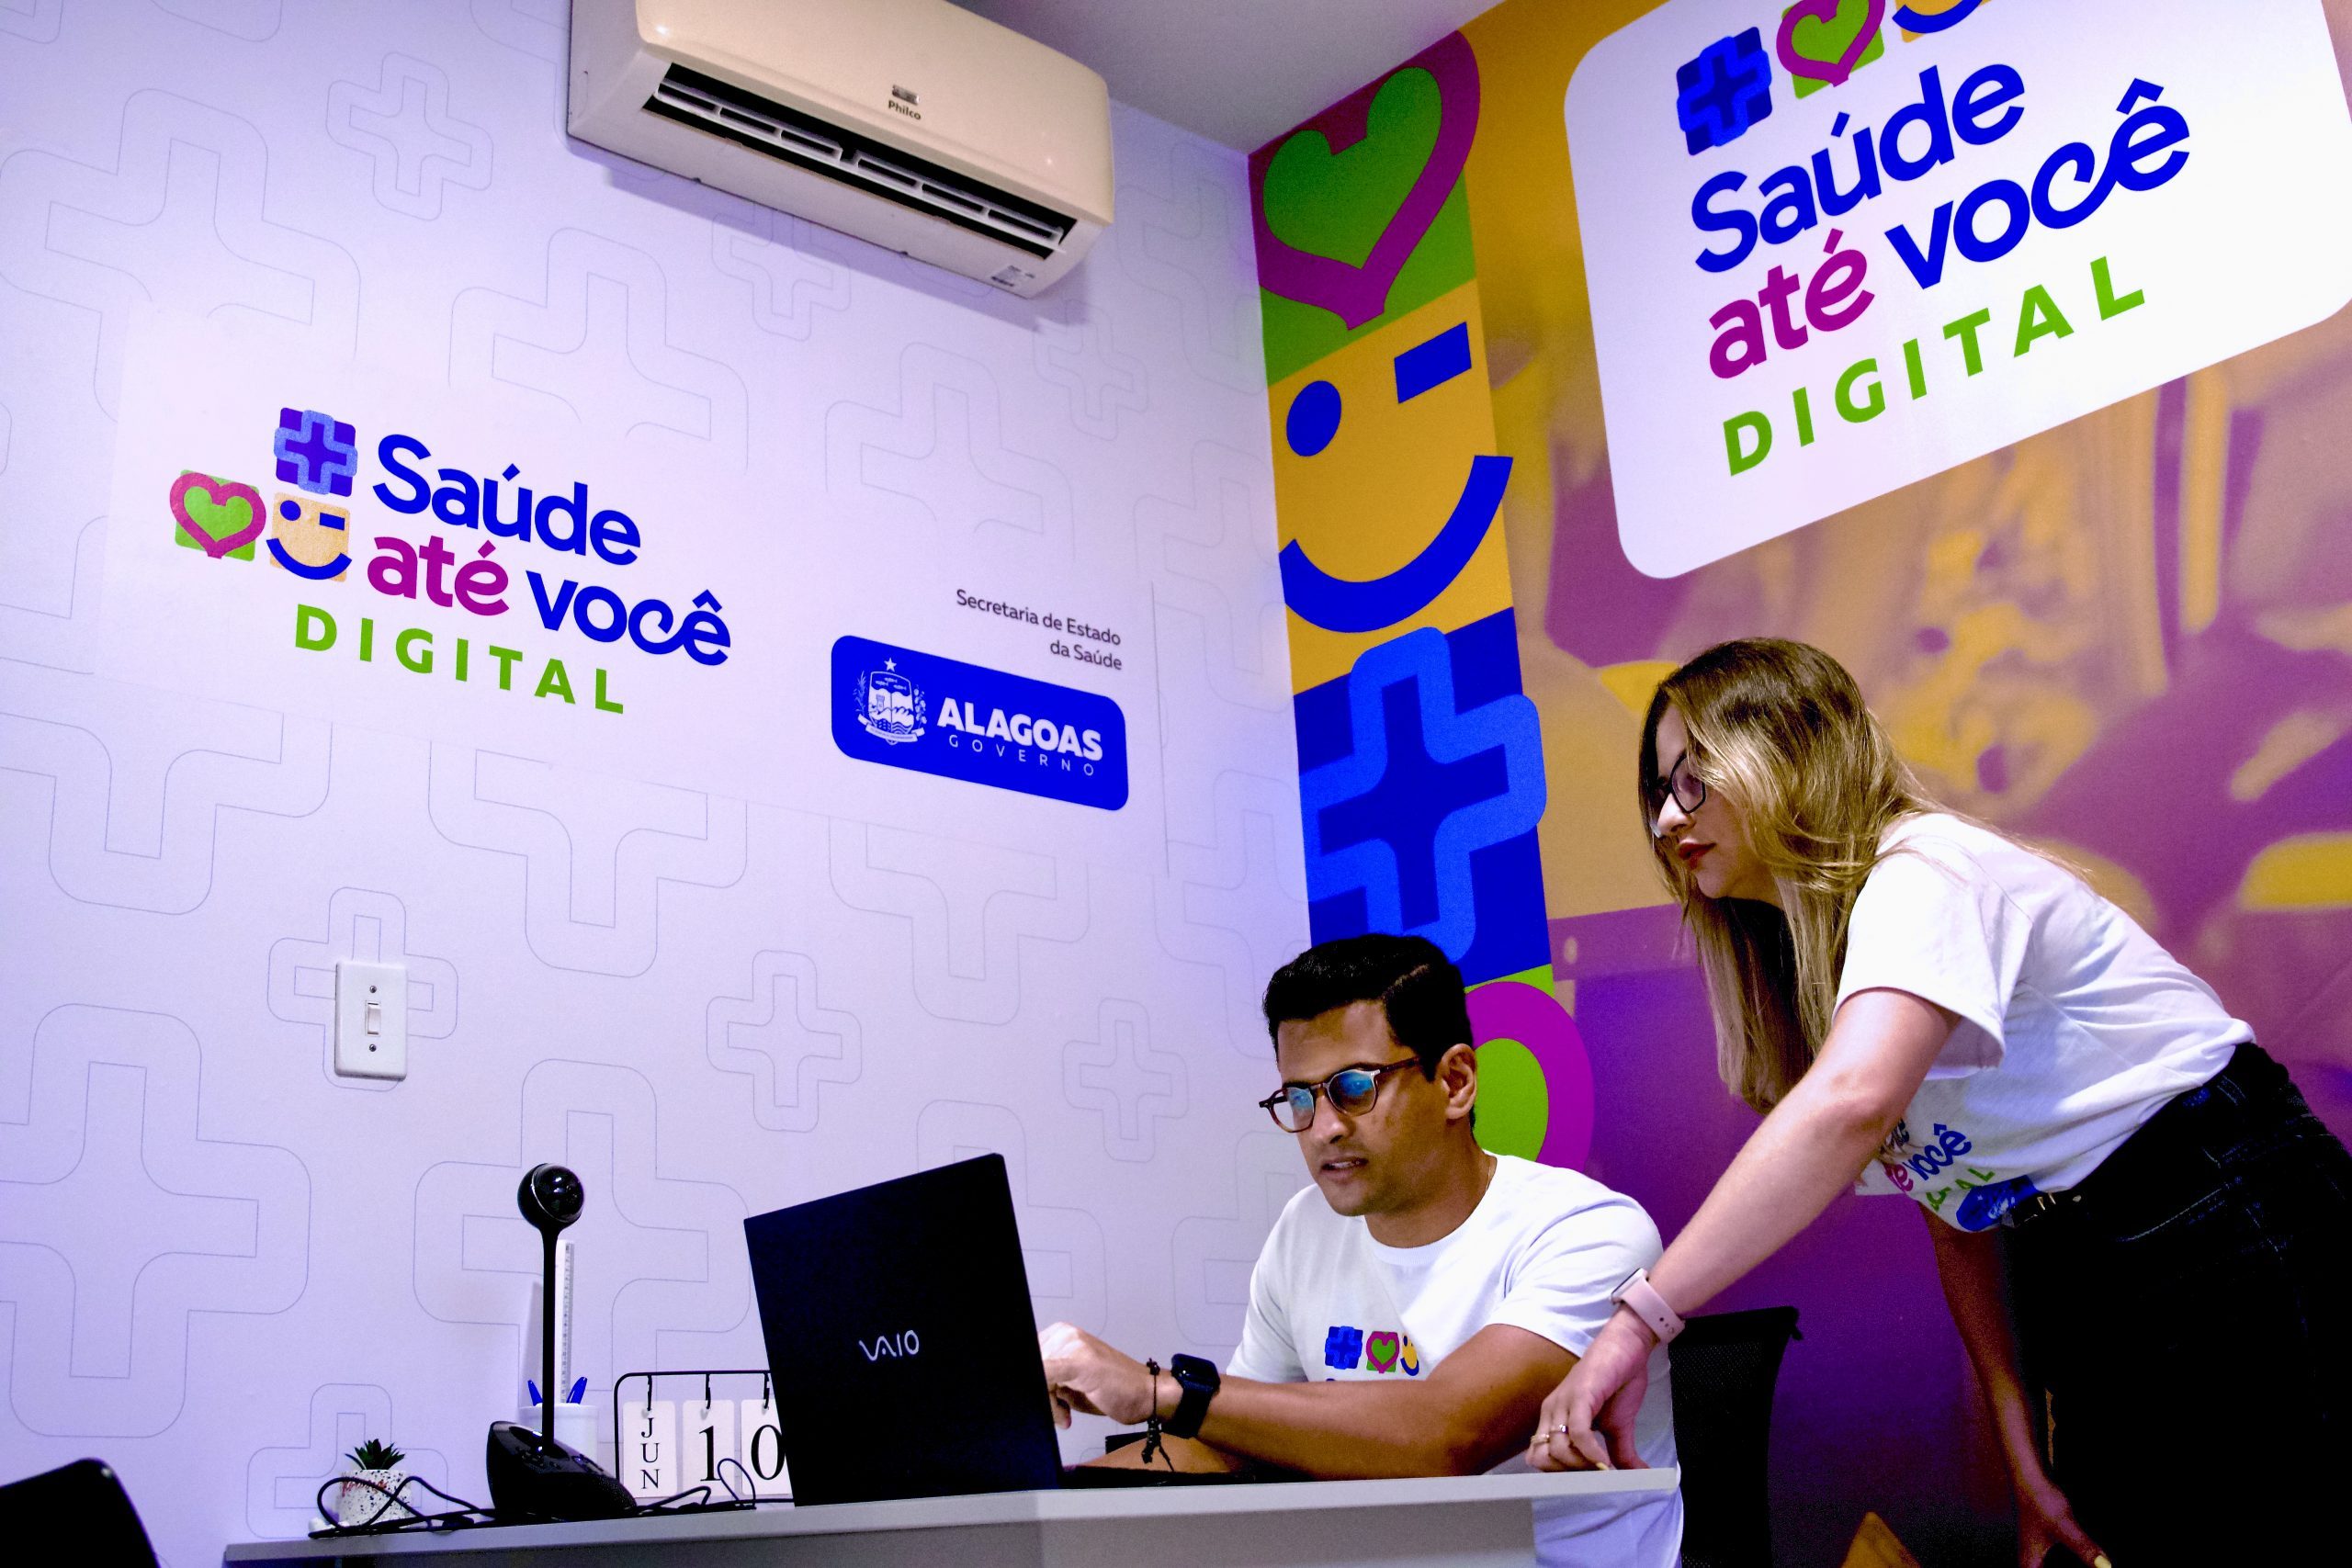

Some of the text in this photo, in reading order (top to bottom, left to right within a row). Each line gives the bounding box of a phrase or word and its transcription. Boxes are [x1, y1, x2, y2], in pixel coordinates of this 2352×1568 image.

[888, 100, 922, 120] Philco
[1691, 64, 2025, 273] Saúde
[1709, 78, 2190, 379] até você
[1723, 256, 2145, 476] DIGITAL
[372, 434, 641, 566] Saúde
[367, 535, 731, 666] até você
[956, 589, 1121, 646] Secretaria de Estado
[295, 604, 624, 714] DIGITAL
[1049, 640, 1123, 671] da Saúde
[937, 697, 1103, 761] ALAGOAS
[949, 735, 1094, 776] GOVERNO
[858, 1329, 920, 1361] VAIO
[640, 1417, 660, 1490] JUN
